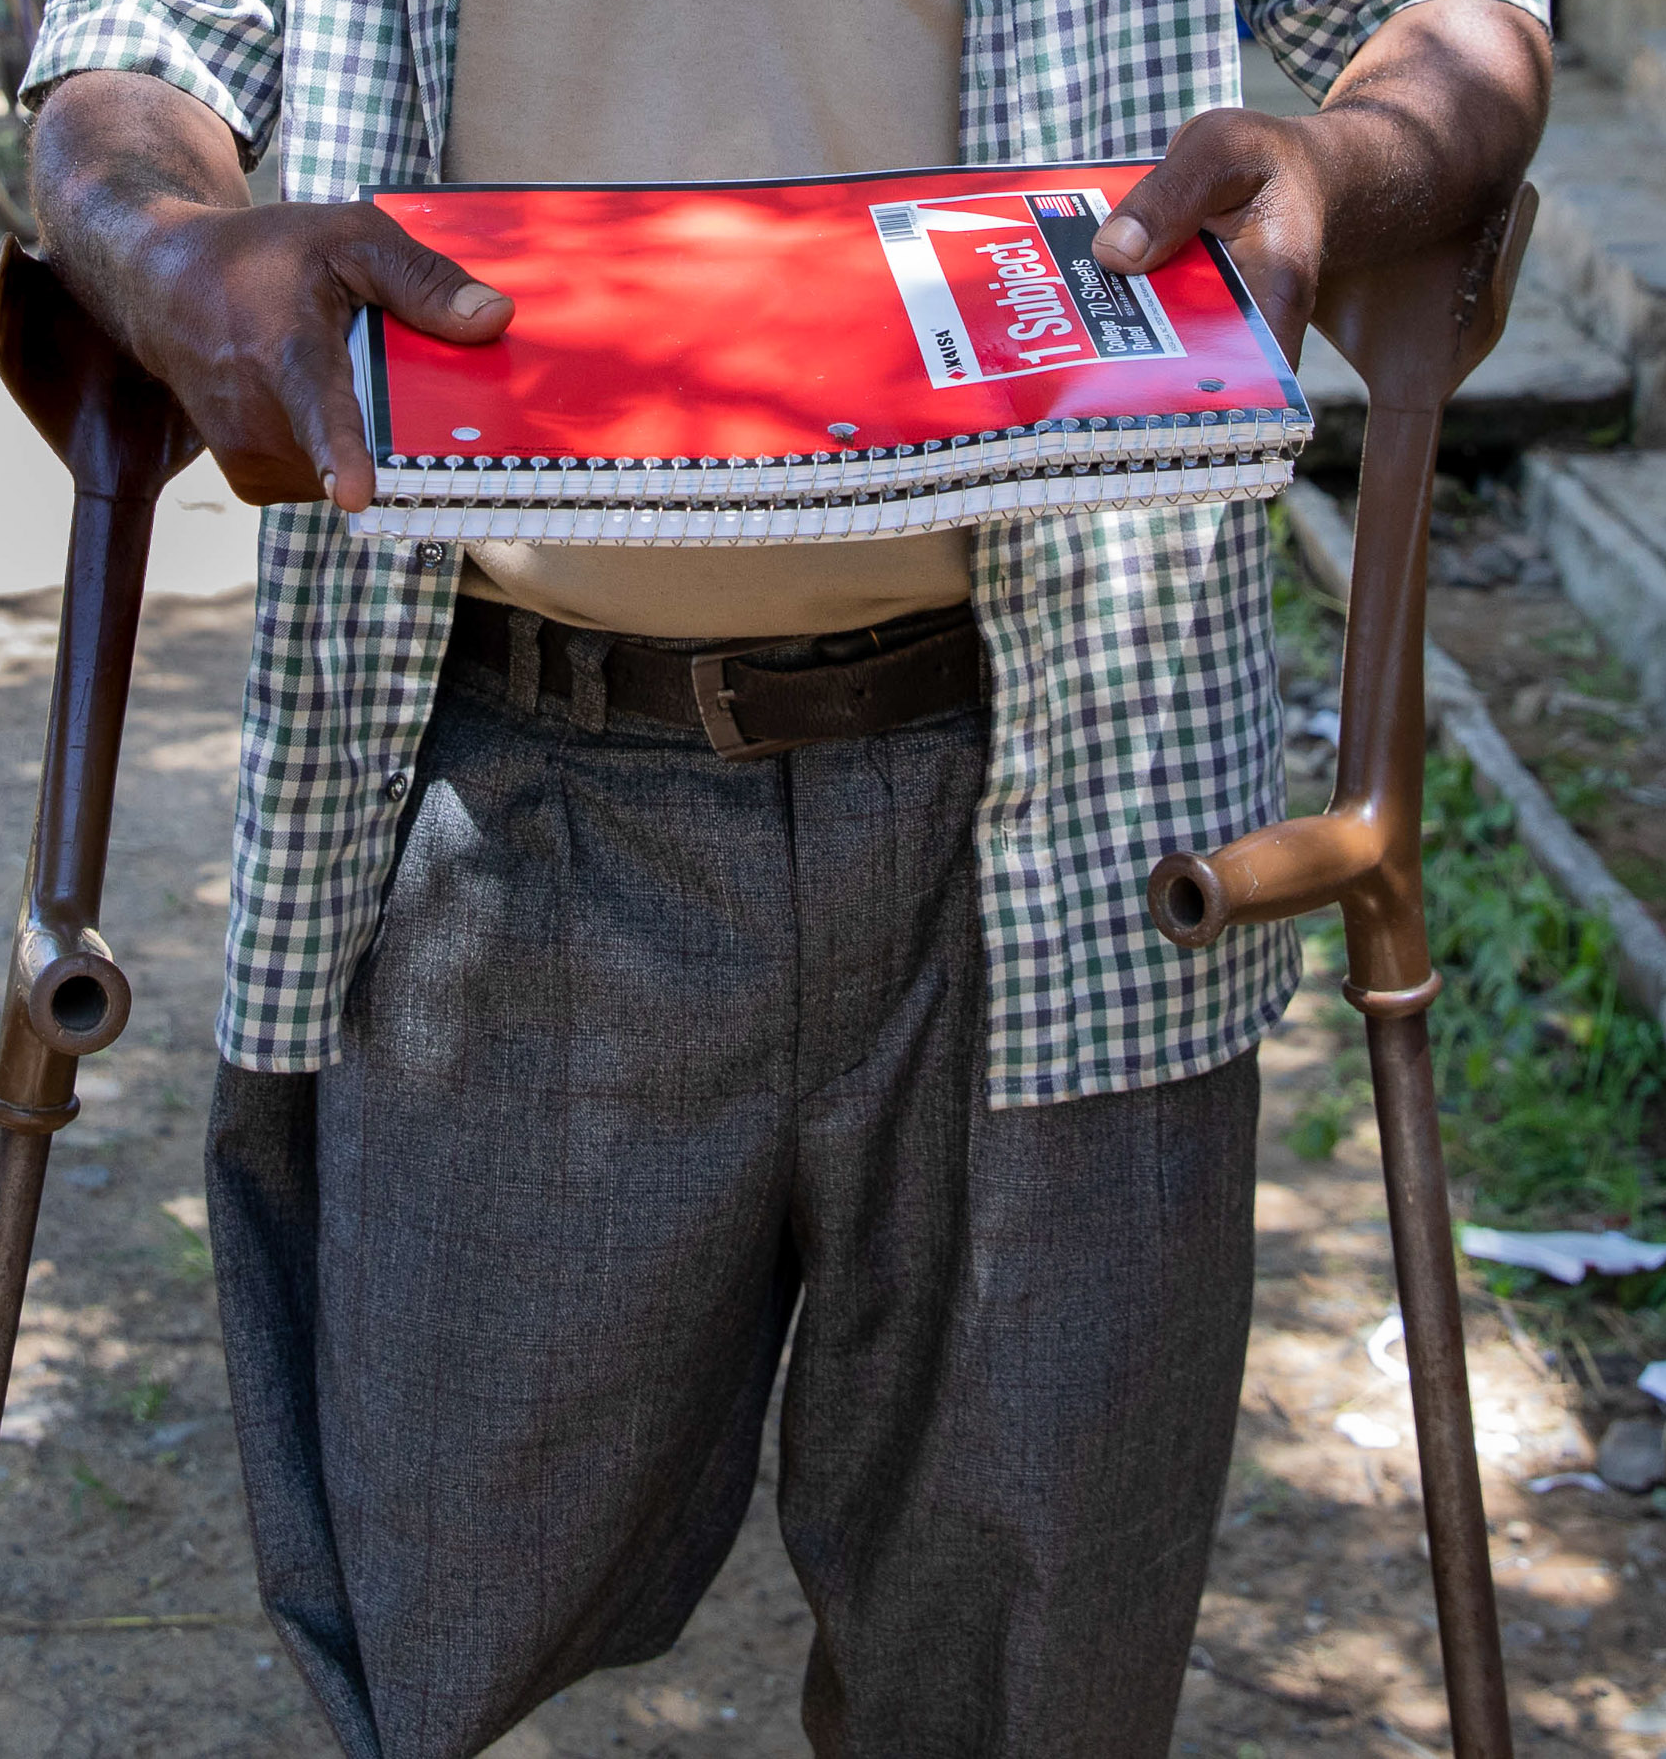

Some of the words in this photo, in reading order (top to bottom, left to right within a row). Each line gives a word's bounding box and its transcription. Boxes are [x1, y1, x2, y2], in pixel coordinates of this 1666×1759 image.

[975, 238, 1073, 341] Subject
[1070, 259, 1107, 299] Sheets
[1087, 302, 1116, 318] 70
[935, 329, 962, 368] KAISA
[1099, 320, 1128, 353] College
[1123, 326, 1153, 351] Ruled
[1018, 343, 1081, 364] 1
